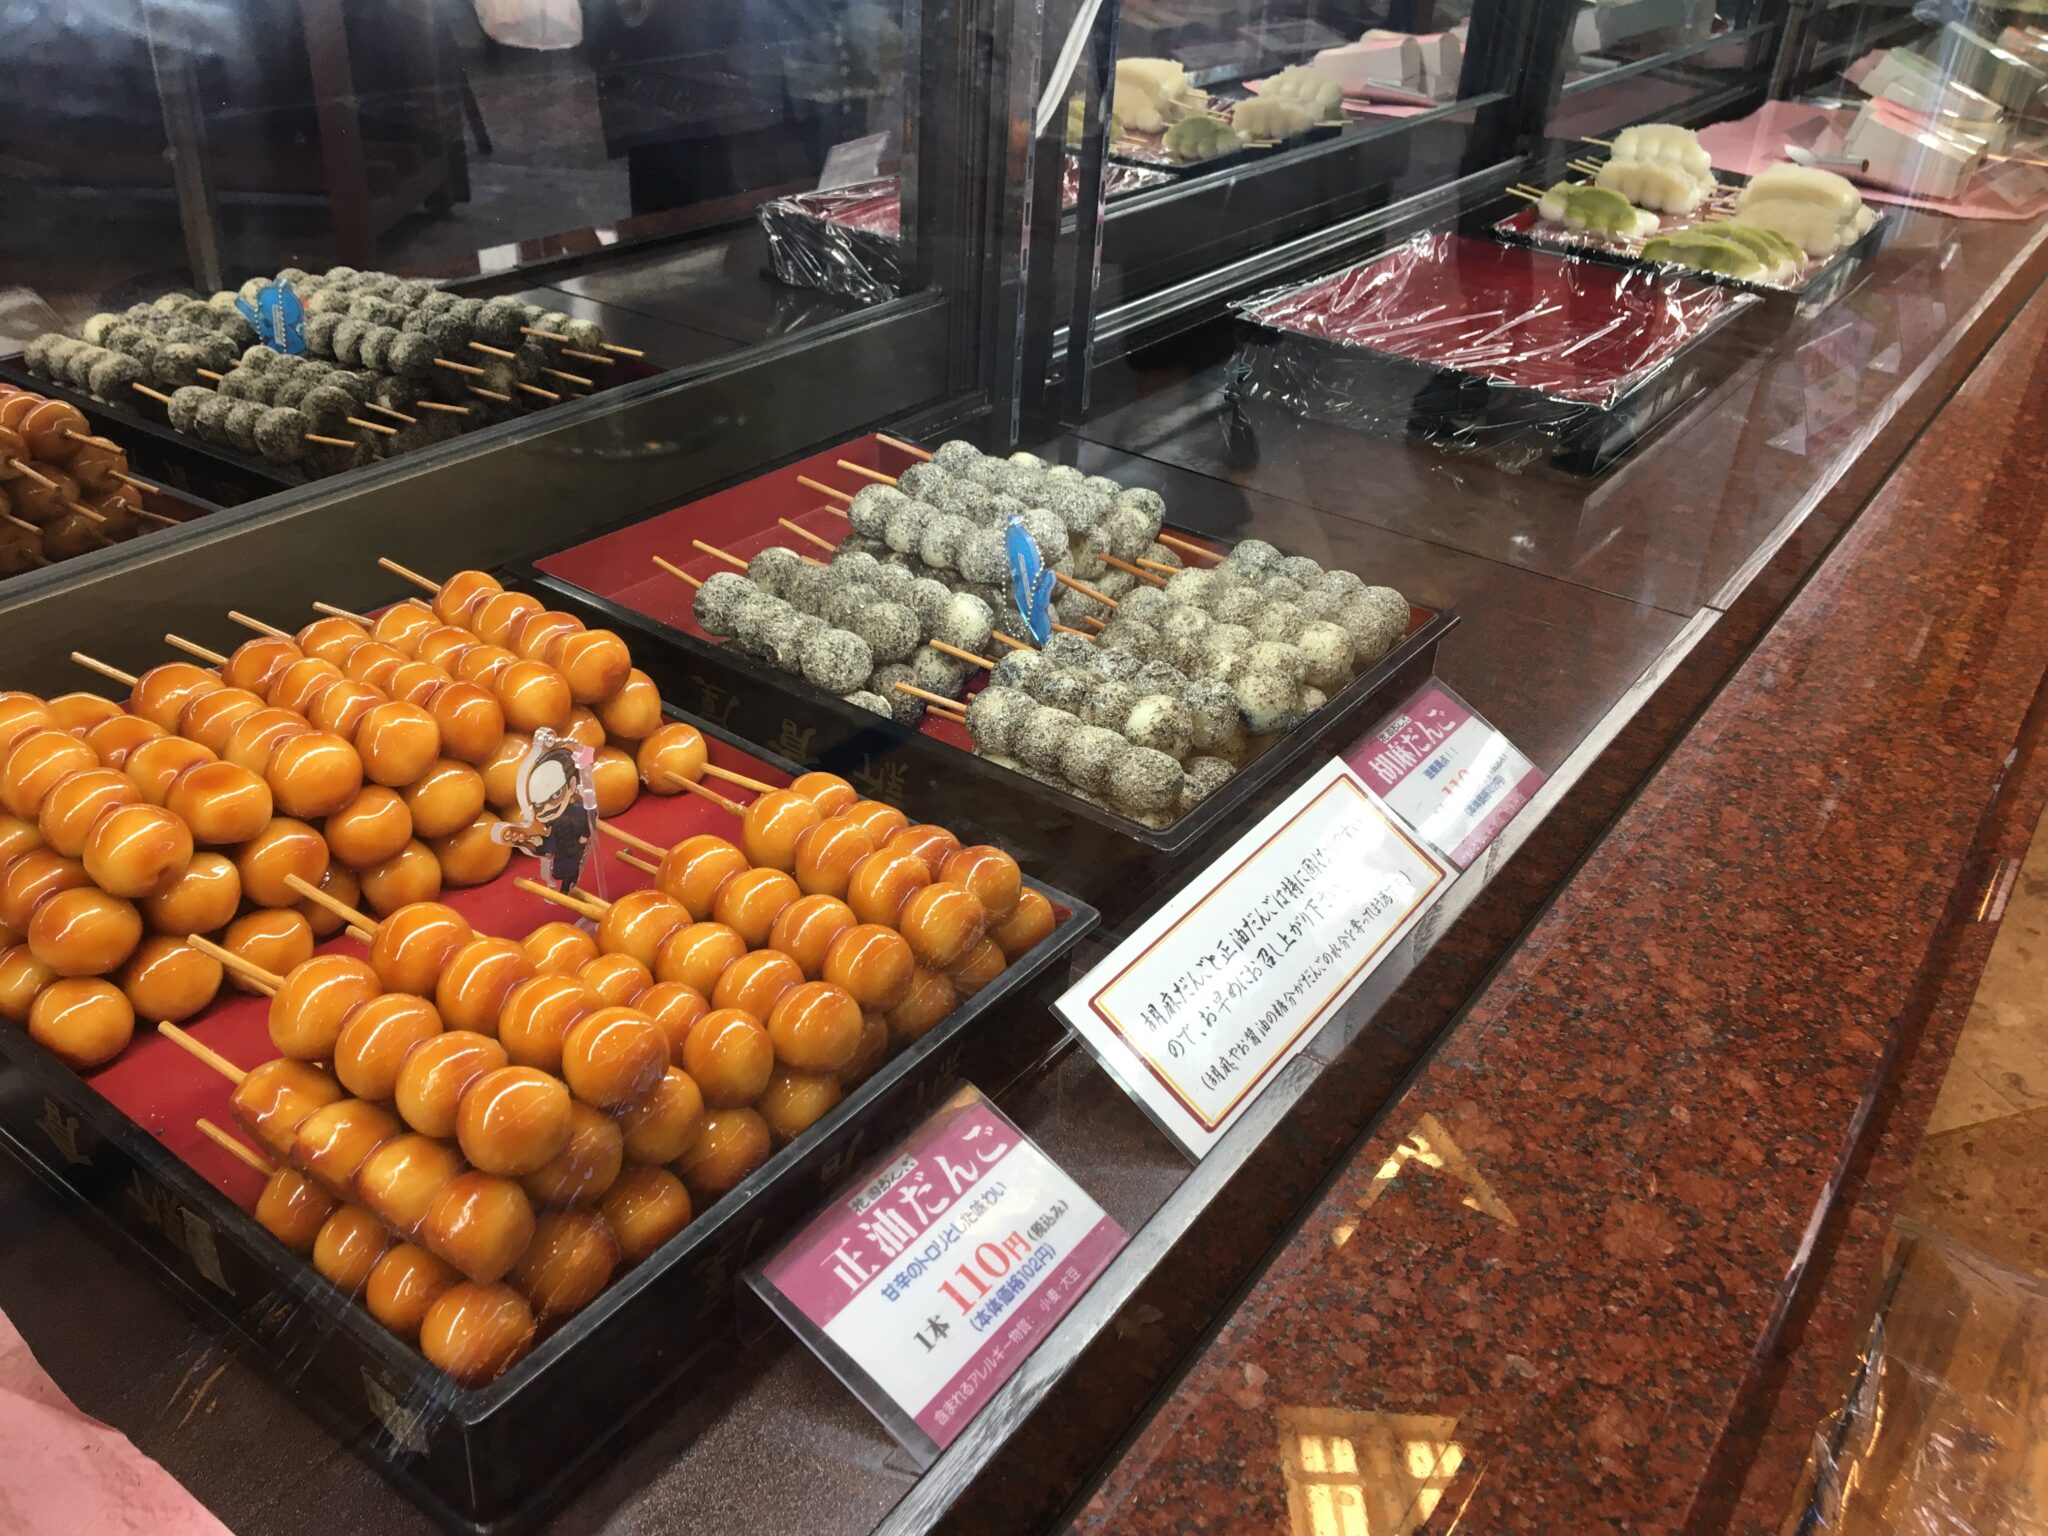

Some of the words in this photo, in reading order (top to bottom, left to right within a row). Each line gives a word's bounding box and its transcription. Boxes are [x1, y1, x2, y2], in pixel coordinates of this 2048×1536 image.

[1368, 709, 1456, 785] 胡麻だんご
[1140, 818, 1363, 1033] 胡麻だんごと正油だんごは特に固くなやすい
[820, 1125, 1008, 1295] 正油だんご
[880, 1181, 1007, 1302] 甘辛のトロリとした味わい
[913, 1315, 951, 1353] 1本
[938, 1231, 1033, 1317] 110円
[1026, 1199, 1069, 1243] (税込み)
[969, 1242, 1057, 1333] (本体価格102円)
